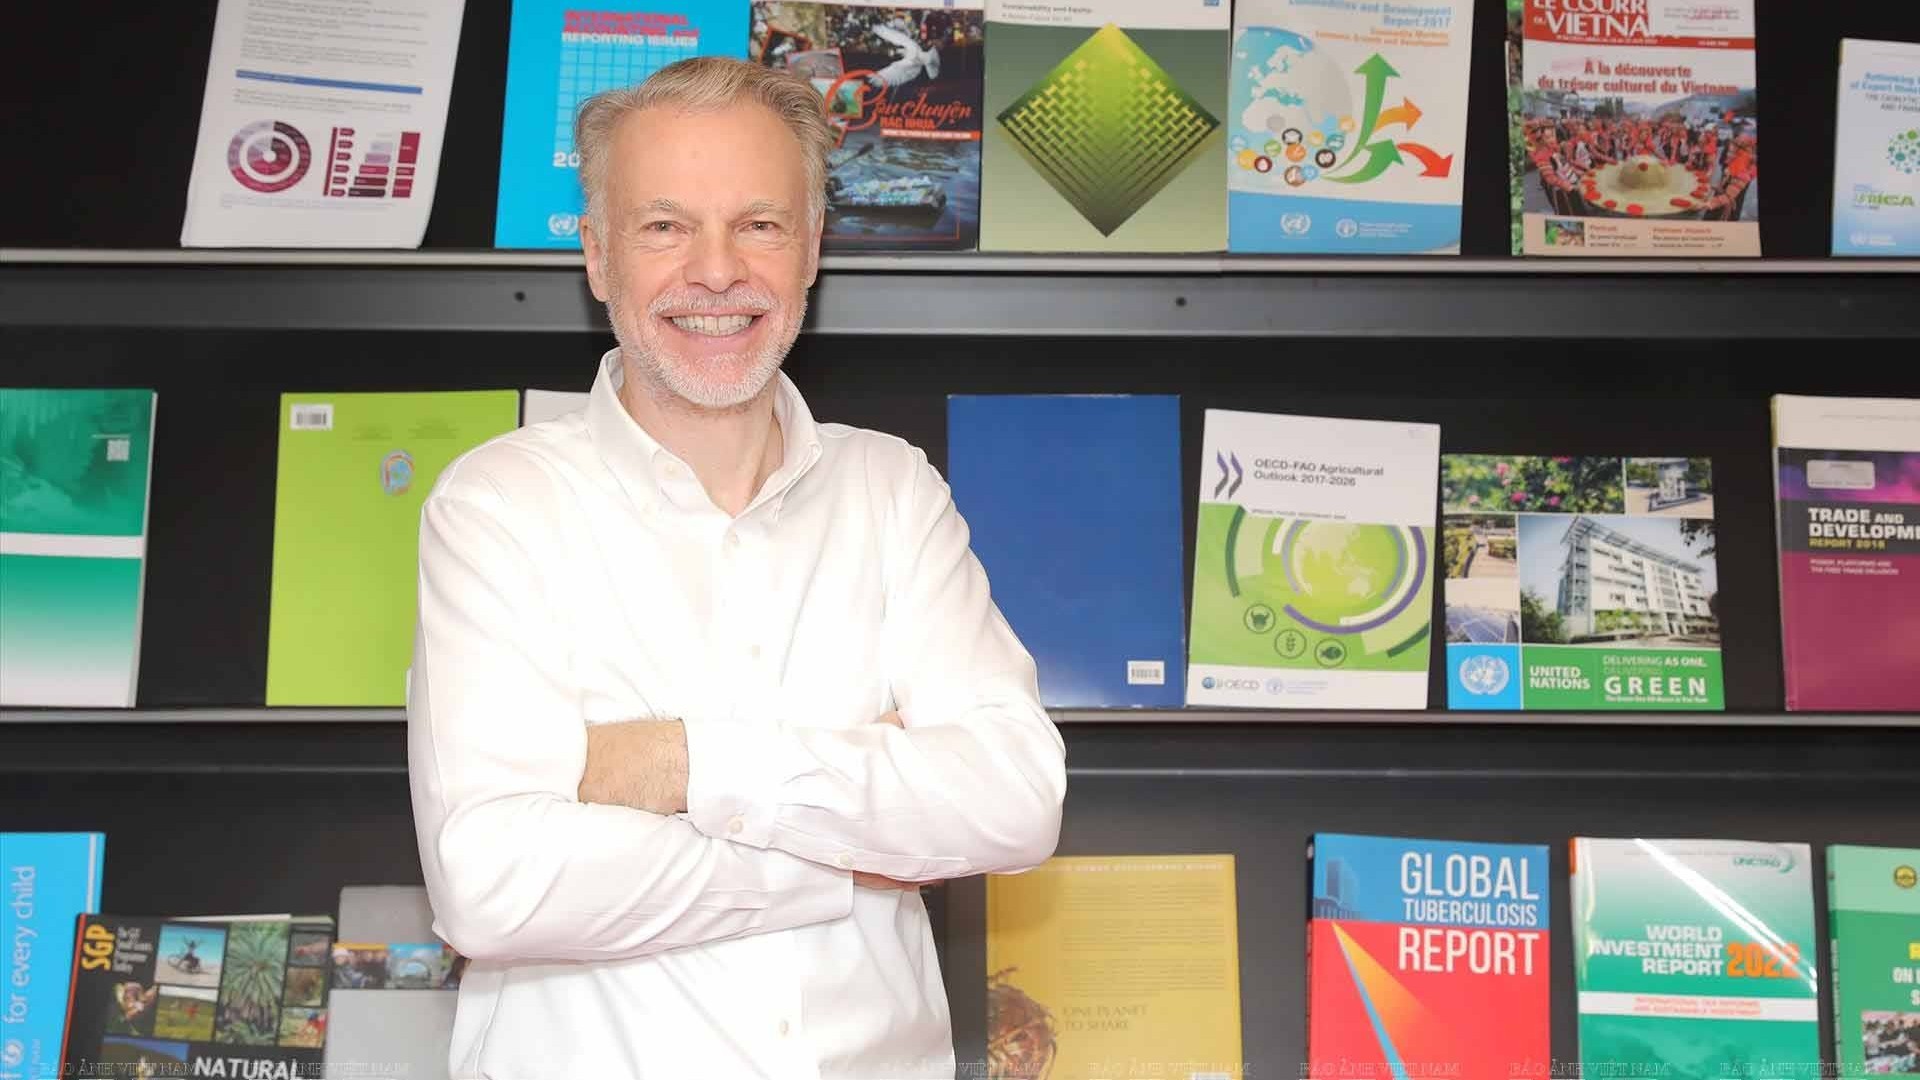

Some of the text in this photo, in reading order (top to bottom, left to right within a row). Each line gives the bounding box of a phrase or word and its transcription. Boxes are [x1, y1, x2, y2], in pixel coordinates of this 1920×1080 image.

[562, 32, 698, 47] REPORTING ISSUES
[1598, 62, 1611, 76] la
[1615, 63, 1692, 78] découverte
[1538, 75, 1738, 95] du trésor culturel du Vietnam
[1254, 458, 1384, 477] OECD-FAO Agricultural
[1253, 469, 1356, 487] Outlook 2017-2026
[1808, 507, 1905, 524] TRADE AND
[1809, 538, 1853, 549] REPORT
[1603, 655, 1663, 667] DELIVERING
[1664, 656, 1680, 667] AS
[1529, 665, 1581, 679] UNITED
[1529, 678, 1591, 691] NATIONS
[1603, 675, 1707, 697] GREEN
[1401, 850, 1540, 900] GLOBAL
[1402, 897, 1538, 927] TUBERCULOSIS
[1646, 924, 1723, 942] WORLD
[3, 865, 38, 1024] for every child
[81, 923, 115, 971] SGP
[1398, 927, 1541, 976] REPORT
[1589, 939, 1724, 958] INVESTMENT
[1642, 959, 1724, 977] REPORT
[1892, 966, 1913, 984] ON
[1062, 1003, 1150, 1018] ONE PLANET
[1062, 1018, 1131, 1032] TO SHARE
[194, 1056, 300, 1080] NATURAL
